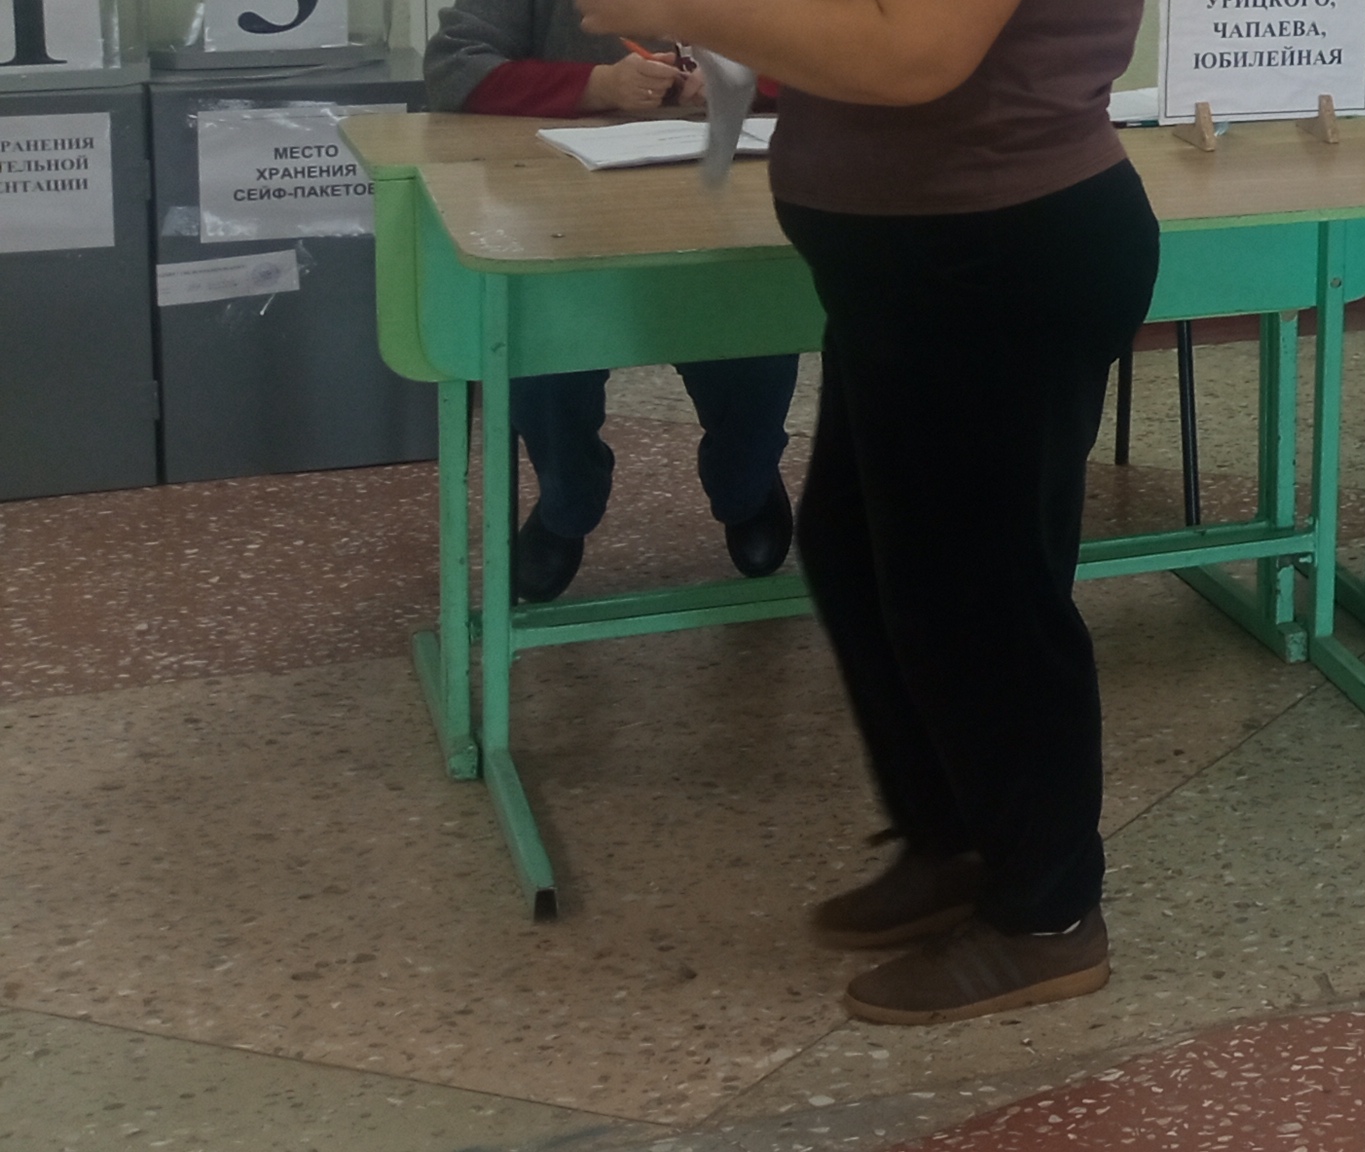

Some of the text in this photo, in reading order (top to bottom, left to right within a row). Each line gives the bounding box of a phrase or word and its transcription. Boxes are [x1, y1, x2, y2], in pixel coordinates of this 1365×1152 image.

[1213, 20, 1327, 39] ЧАПАЕВА,
[1193, 46, 1343, 69] ЮБИЛЕЙНАЯ
[0, 136, 95, 153] РАНЕНИЯ
[273, 144, 339, 161] МЕСТО
[256, 163, 357, 181] ХРАНЕНИЯ
[233, 182, 375, 202] СЕЙФ-ПАКЕТОВ
